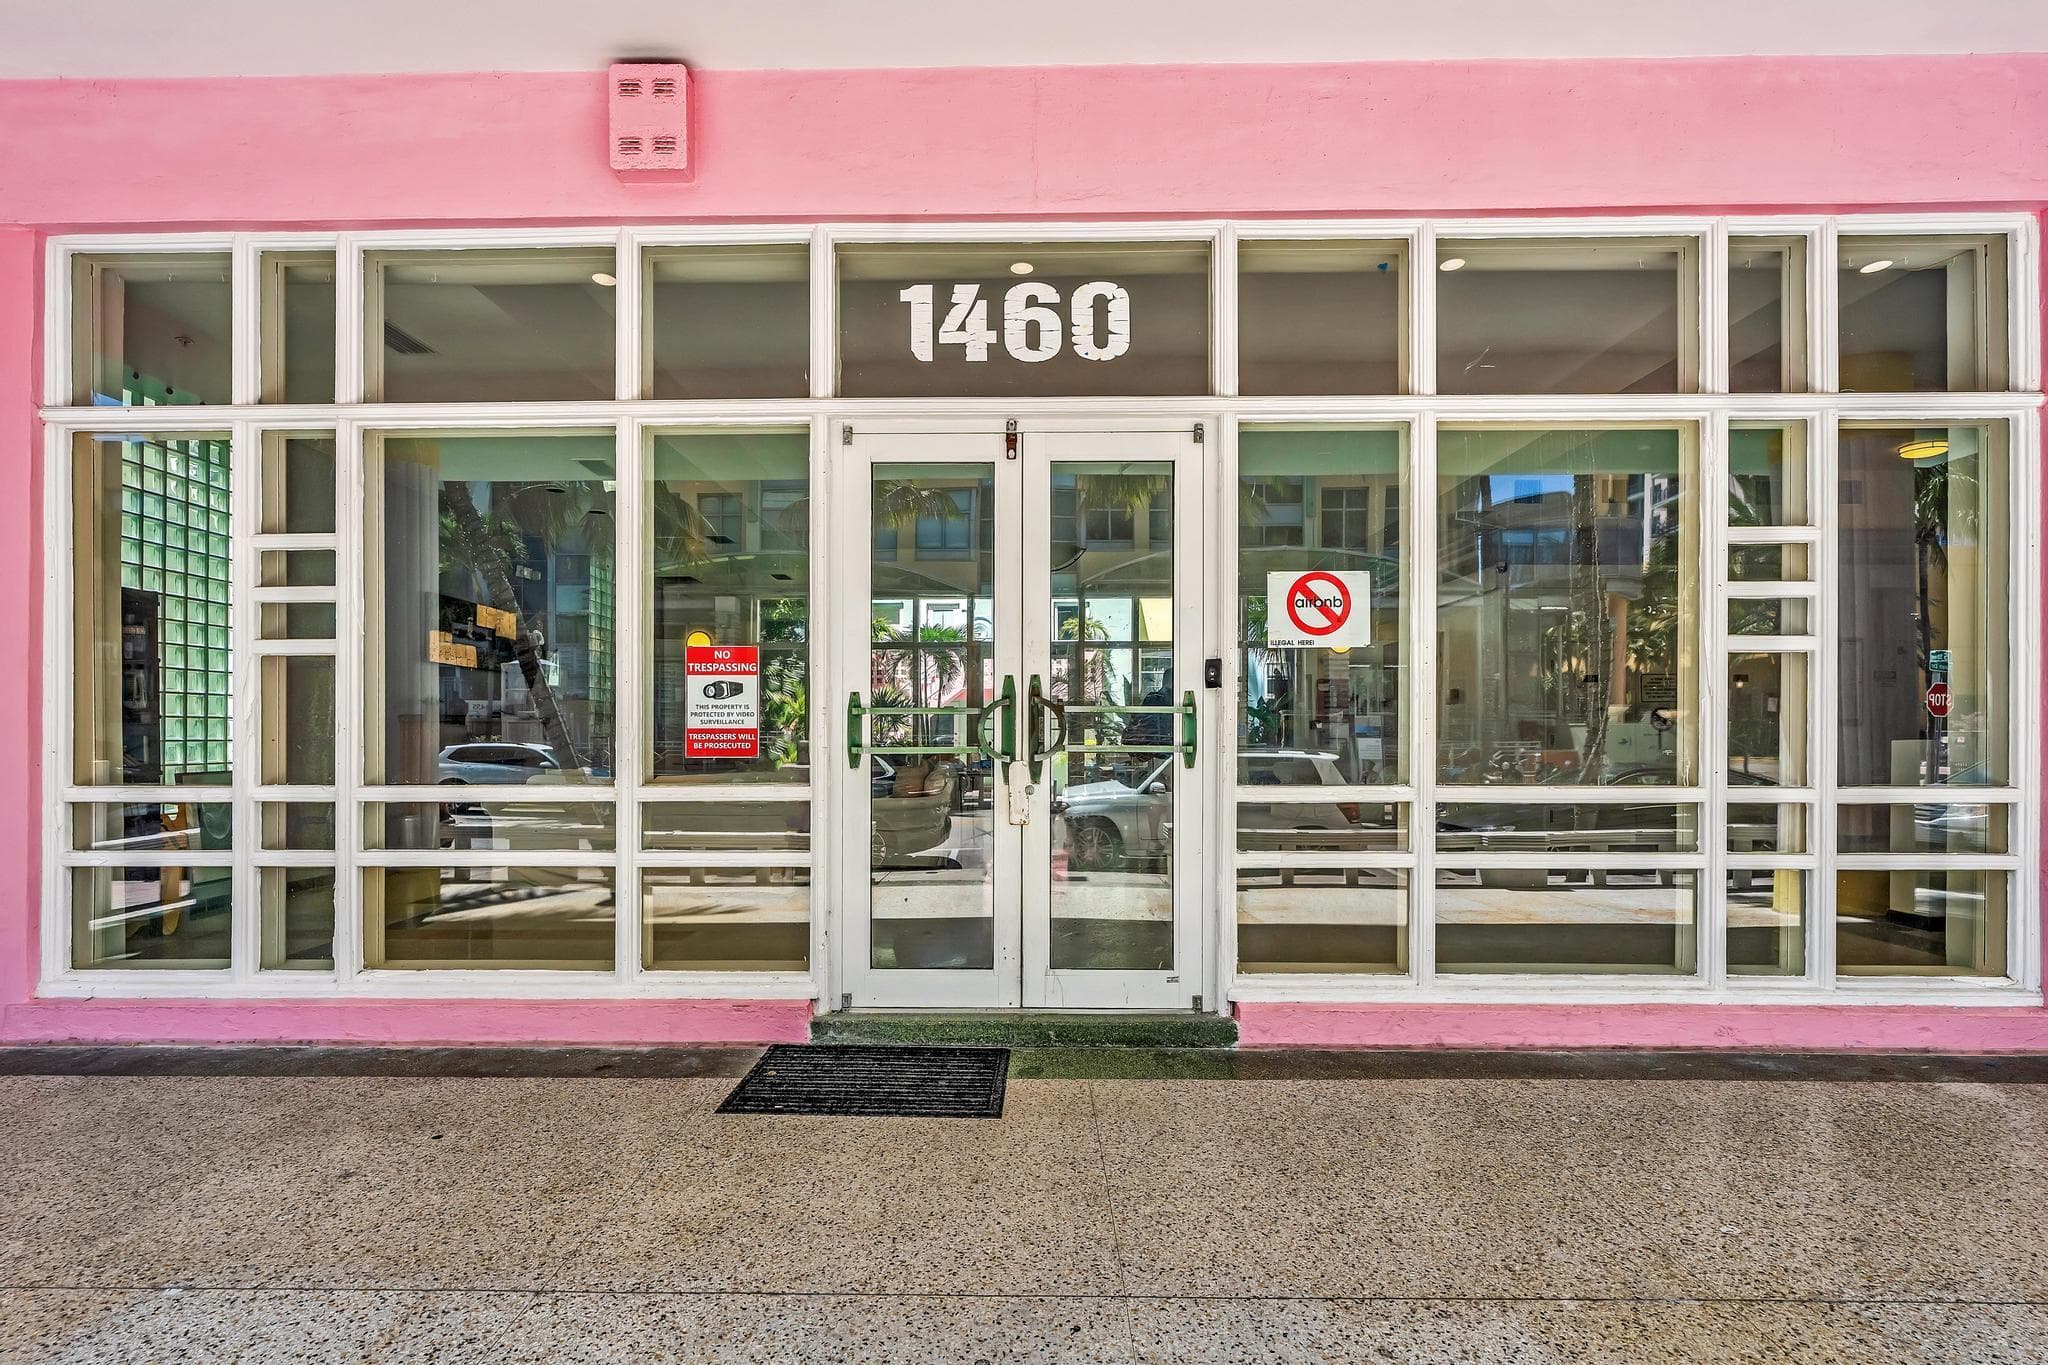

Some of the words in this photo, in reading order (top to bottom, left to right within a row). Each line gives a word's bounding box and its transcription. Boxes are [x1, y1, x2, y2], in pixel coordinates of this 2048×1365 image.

[900, 281, 1130, 362] 1460
[1295, 596, 1343, 608] airbnb
[714, 650, 731, 659] NO
[688, 662, 757, 672] TRESPASSING
